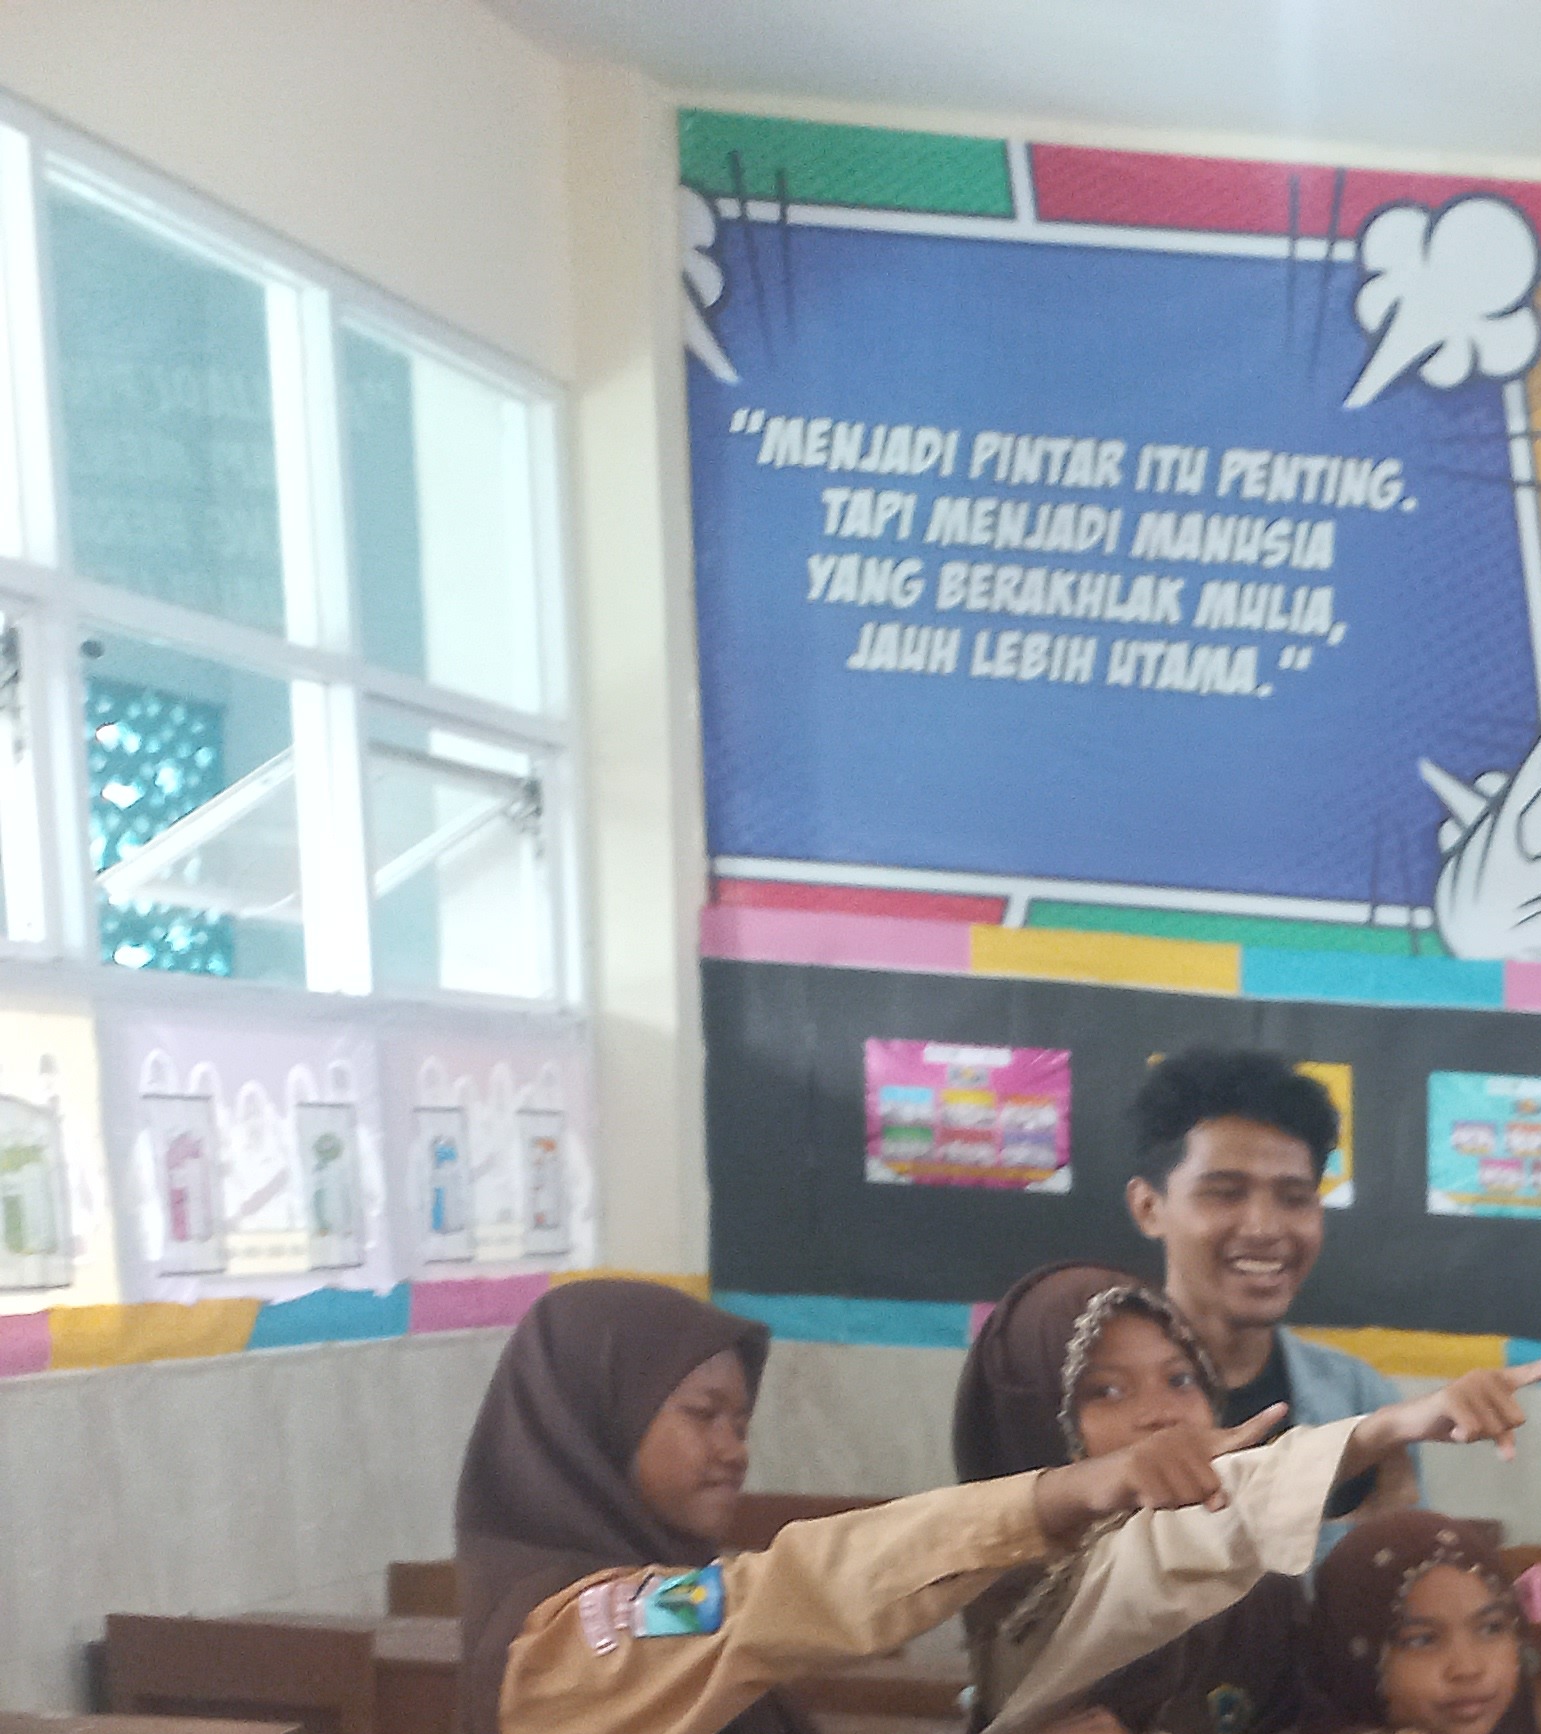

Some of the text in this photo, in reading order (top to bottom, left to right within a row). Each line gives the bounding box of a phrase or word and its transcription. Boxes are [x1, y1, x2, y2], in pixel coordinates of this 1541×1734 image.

[730, 408, 1419, 512] "MENJADI PINTAR ITU PENTING.
[821, 487, 1335, 571] TAPI MENJADI MANUSIA
[806, 553, 1348, 646] YANG BERAKHLAK MULIA,
[846, 621, 960, 673] JAUH
[971, 630, 1096, 685] LEBIH
